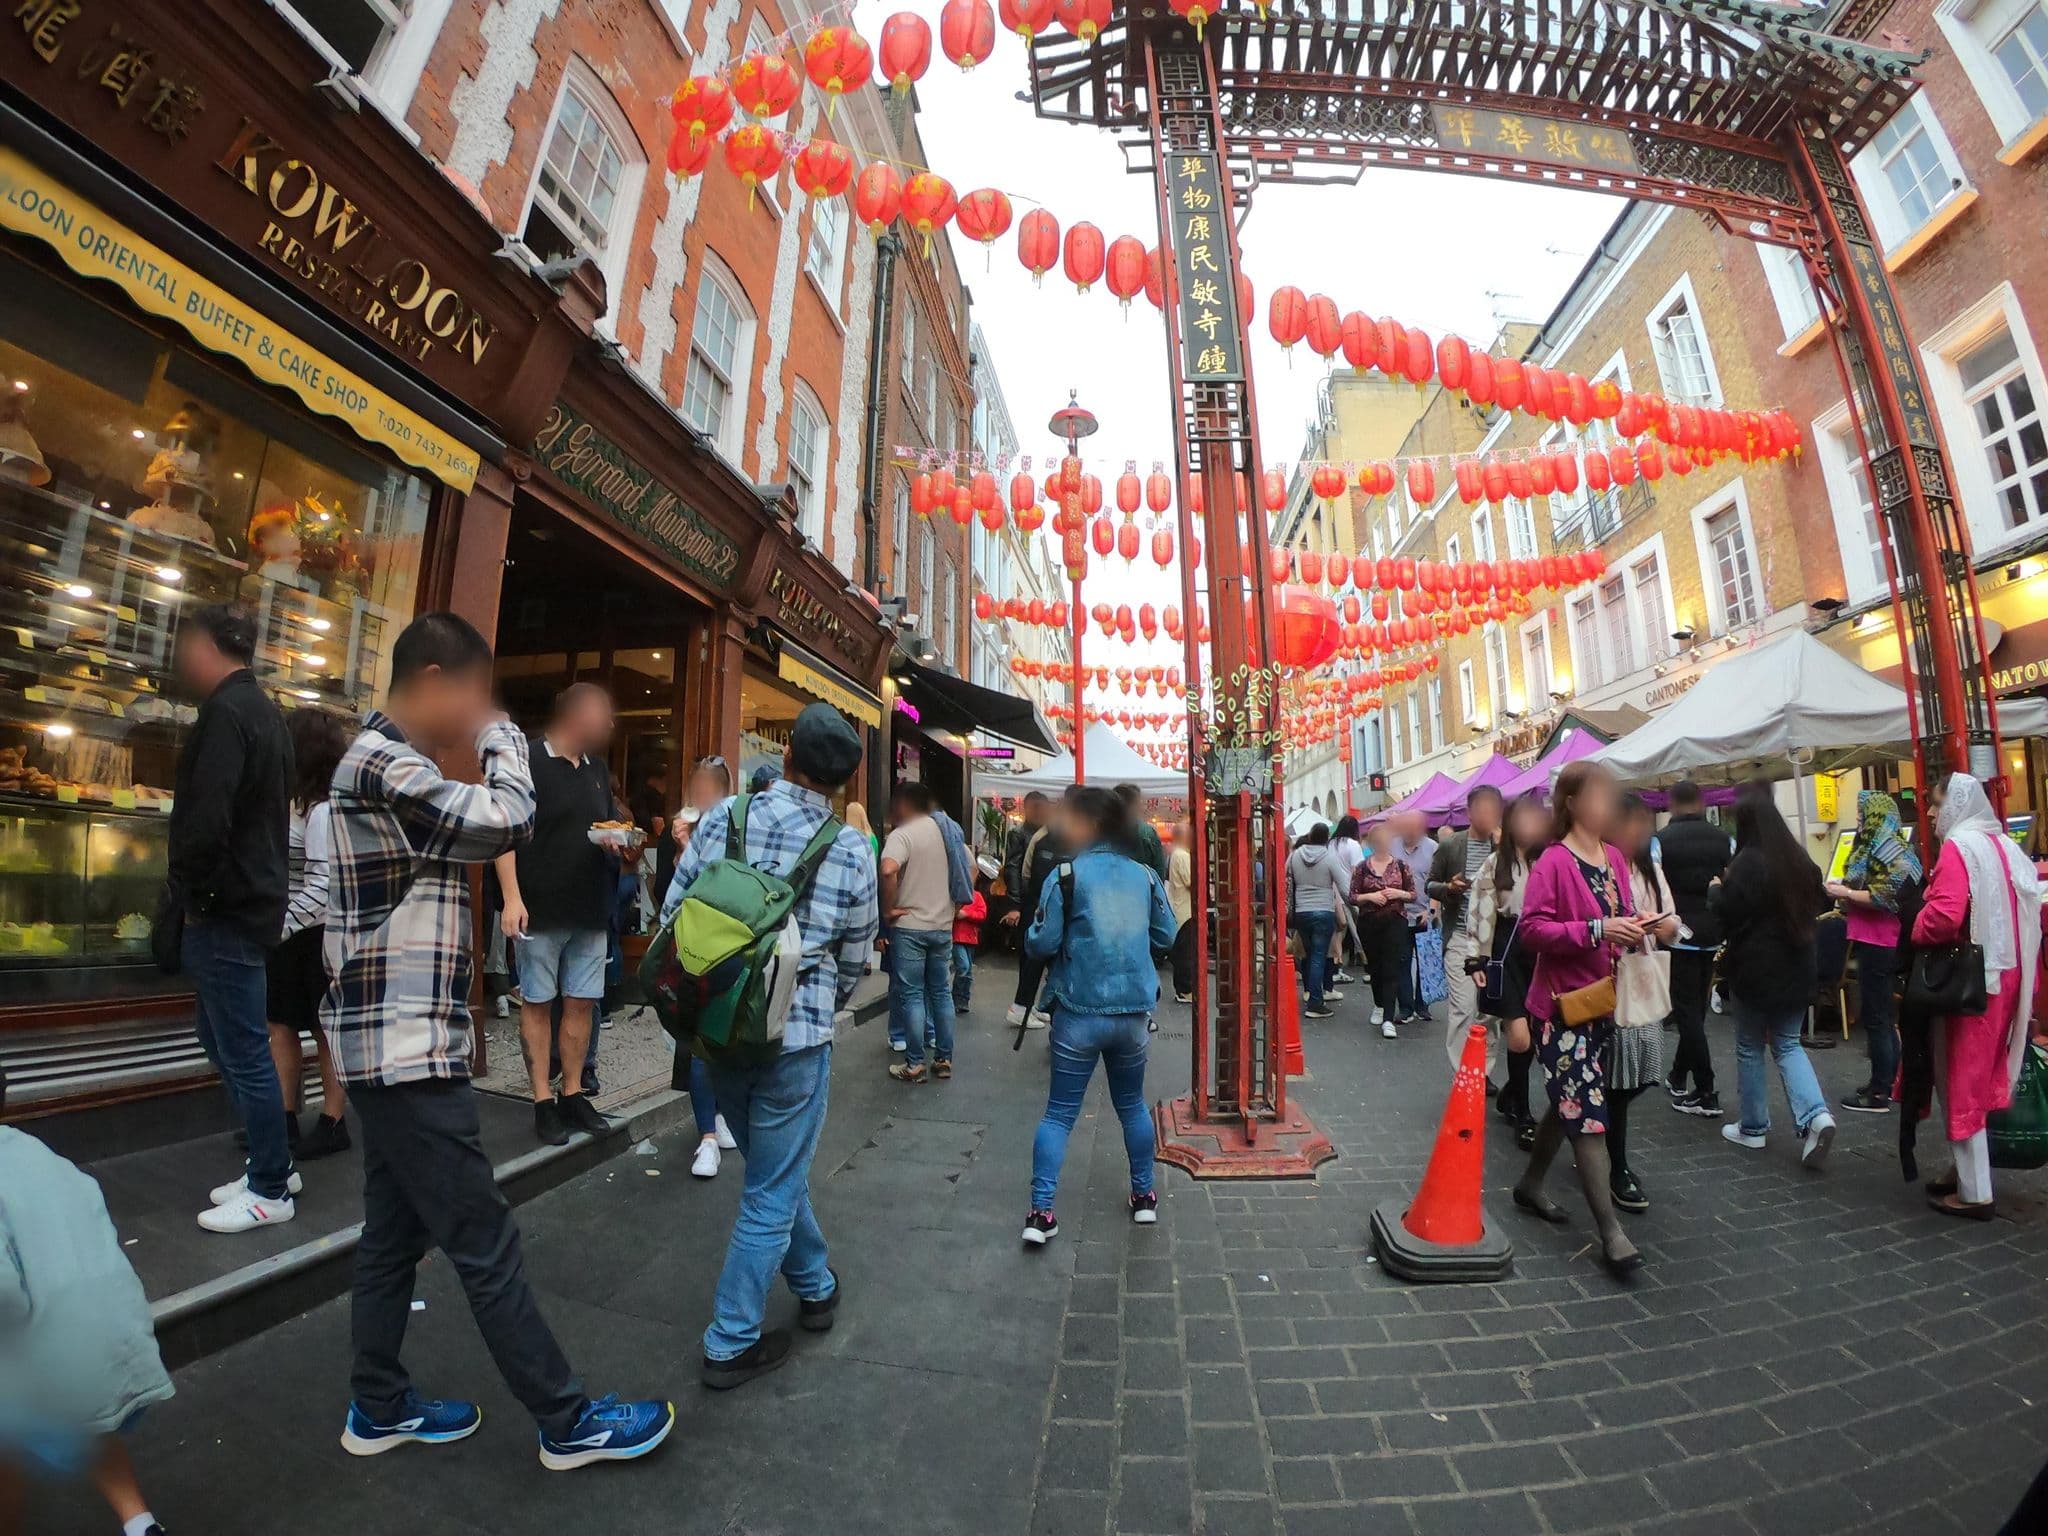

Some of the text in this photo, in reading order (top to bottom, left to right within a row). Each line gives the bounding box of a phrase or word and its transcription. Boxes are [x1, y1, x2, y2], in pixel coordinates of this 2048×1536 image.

[213, 115, 499, 366] KOWLOON
[257, 220, 435, 363] RESTAURANT
[78, 225, 177, 304] ORIENTAL
[186, 291, 255, 347] BUFFET
[258, 336, 275, 360] &
[279, 348, 321, 389] CAKE
[324, 375, 368, 414] SHOP
[378, 410, 411, 442] T:020
[416, 433, 443, 460] 7437
[447, 453, 474, 477] 1694
[535, 406, 573, 452] 21
[550, 424, 654, 515] Gerrard
